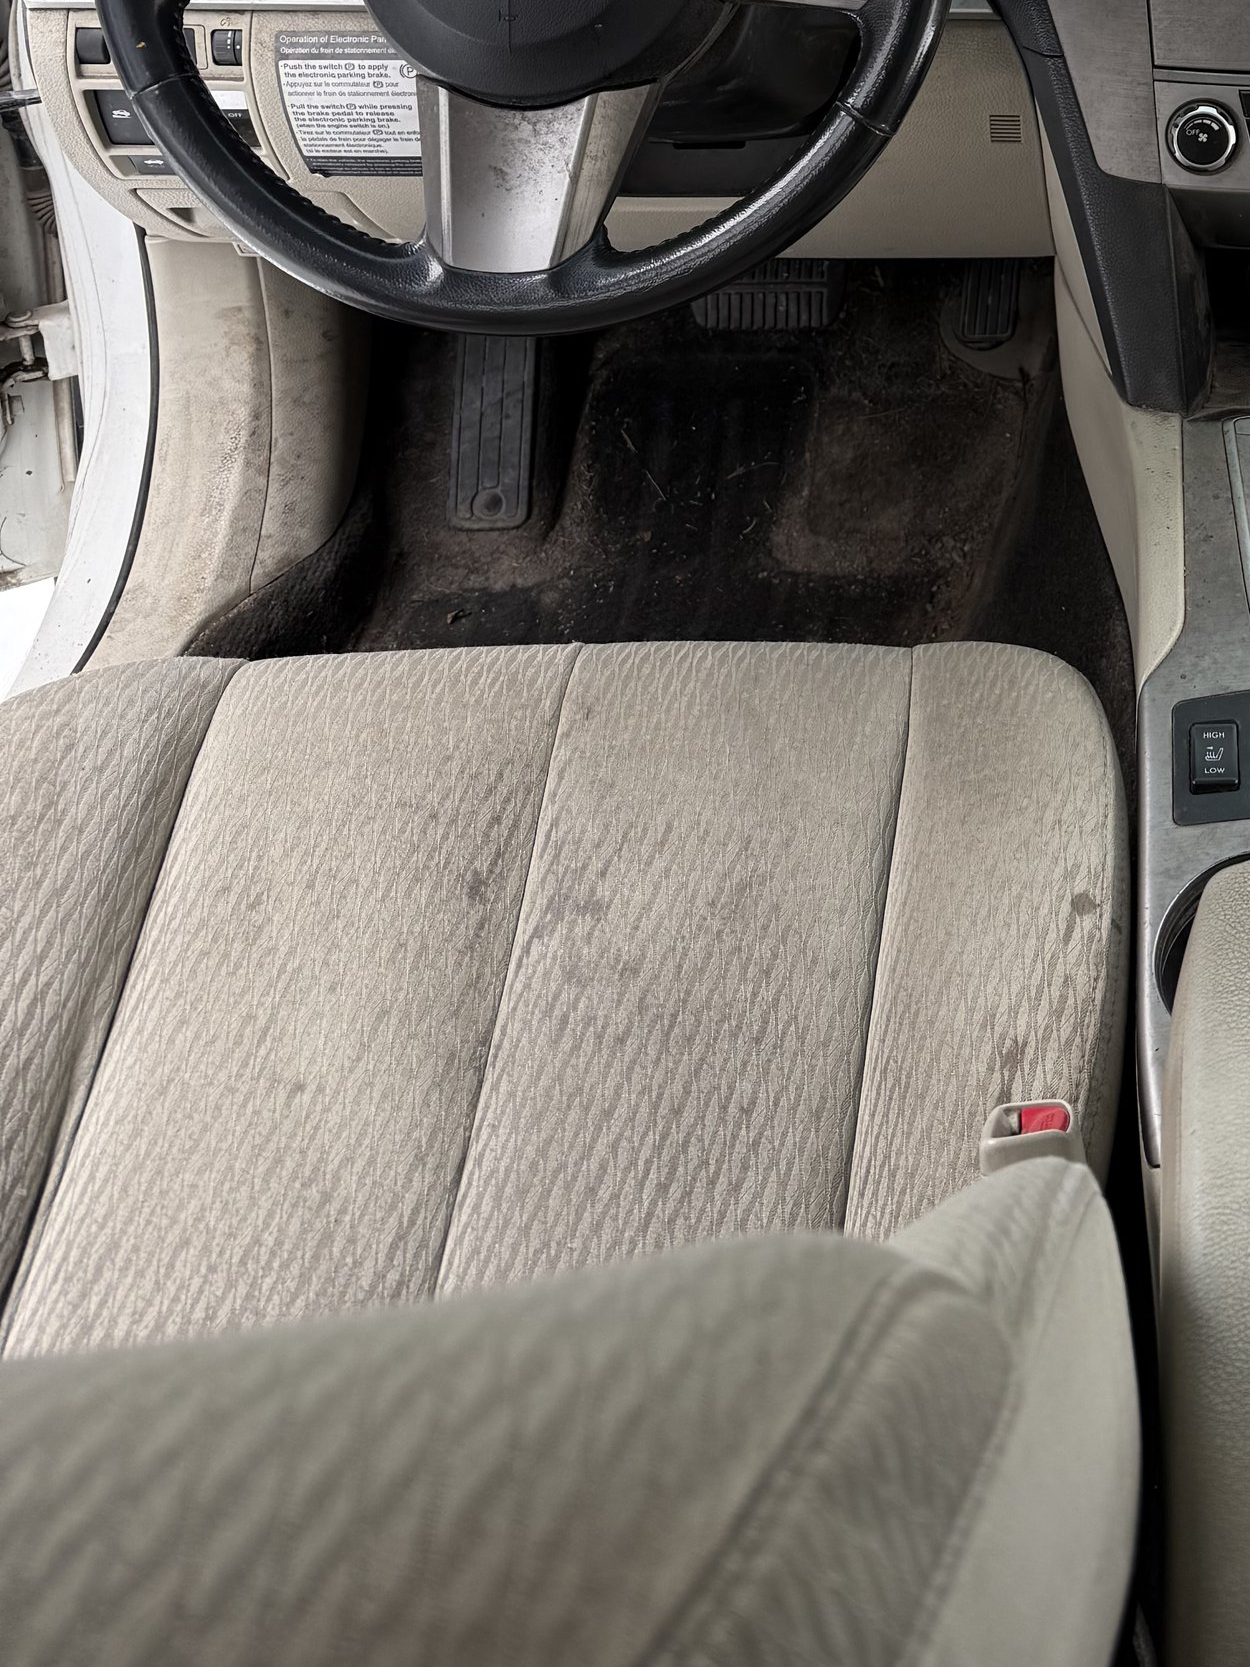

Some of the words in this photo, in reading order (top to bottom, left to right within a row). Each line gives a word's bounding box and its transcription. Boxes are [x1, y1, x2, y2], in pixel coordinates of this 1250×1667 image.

[280, 35, 318, 44] Operation
[320, 35, 328, 43] of
[330, 35, 369, 43] Electronic
[368, 63, 389, 71] apply
[1203, 731, 1225, 739] HIGH
